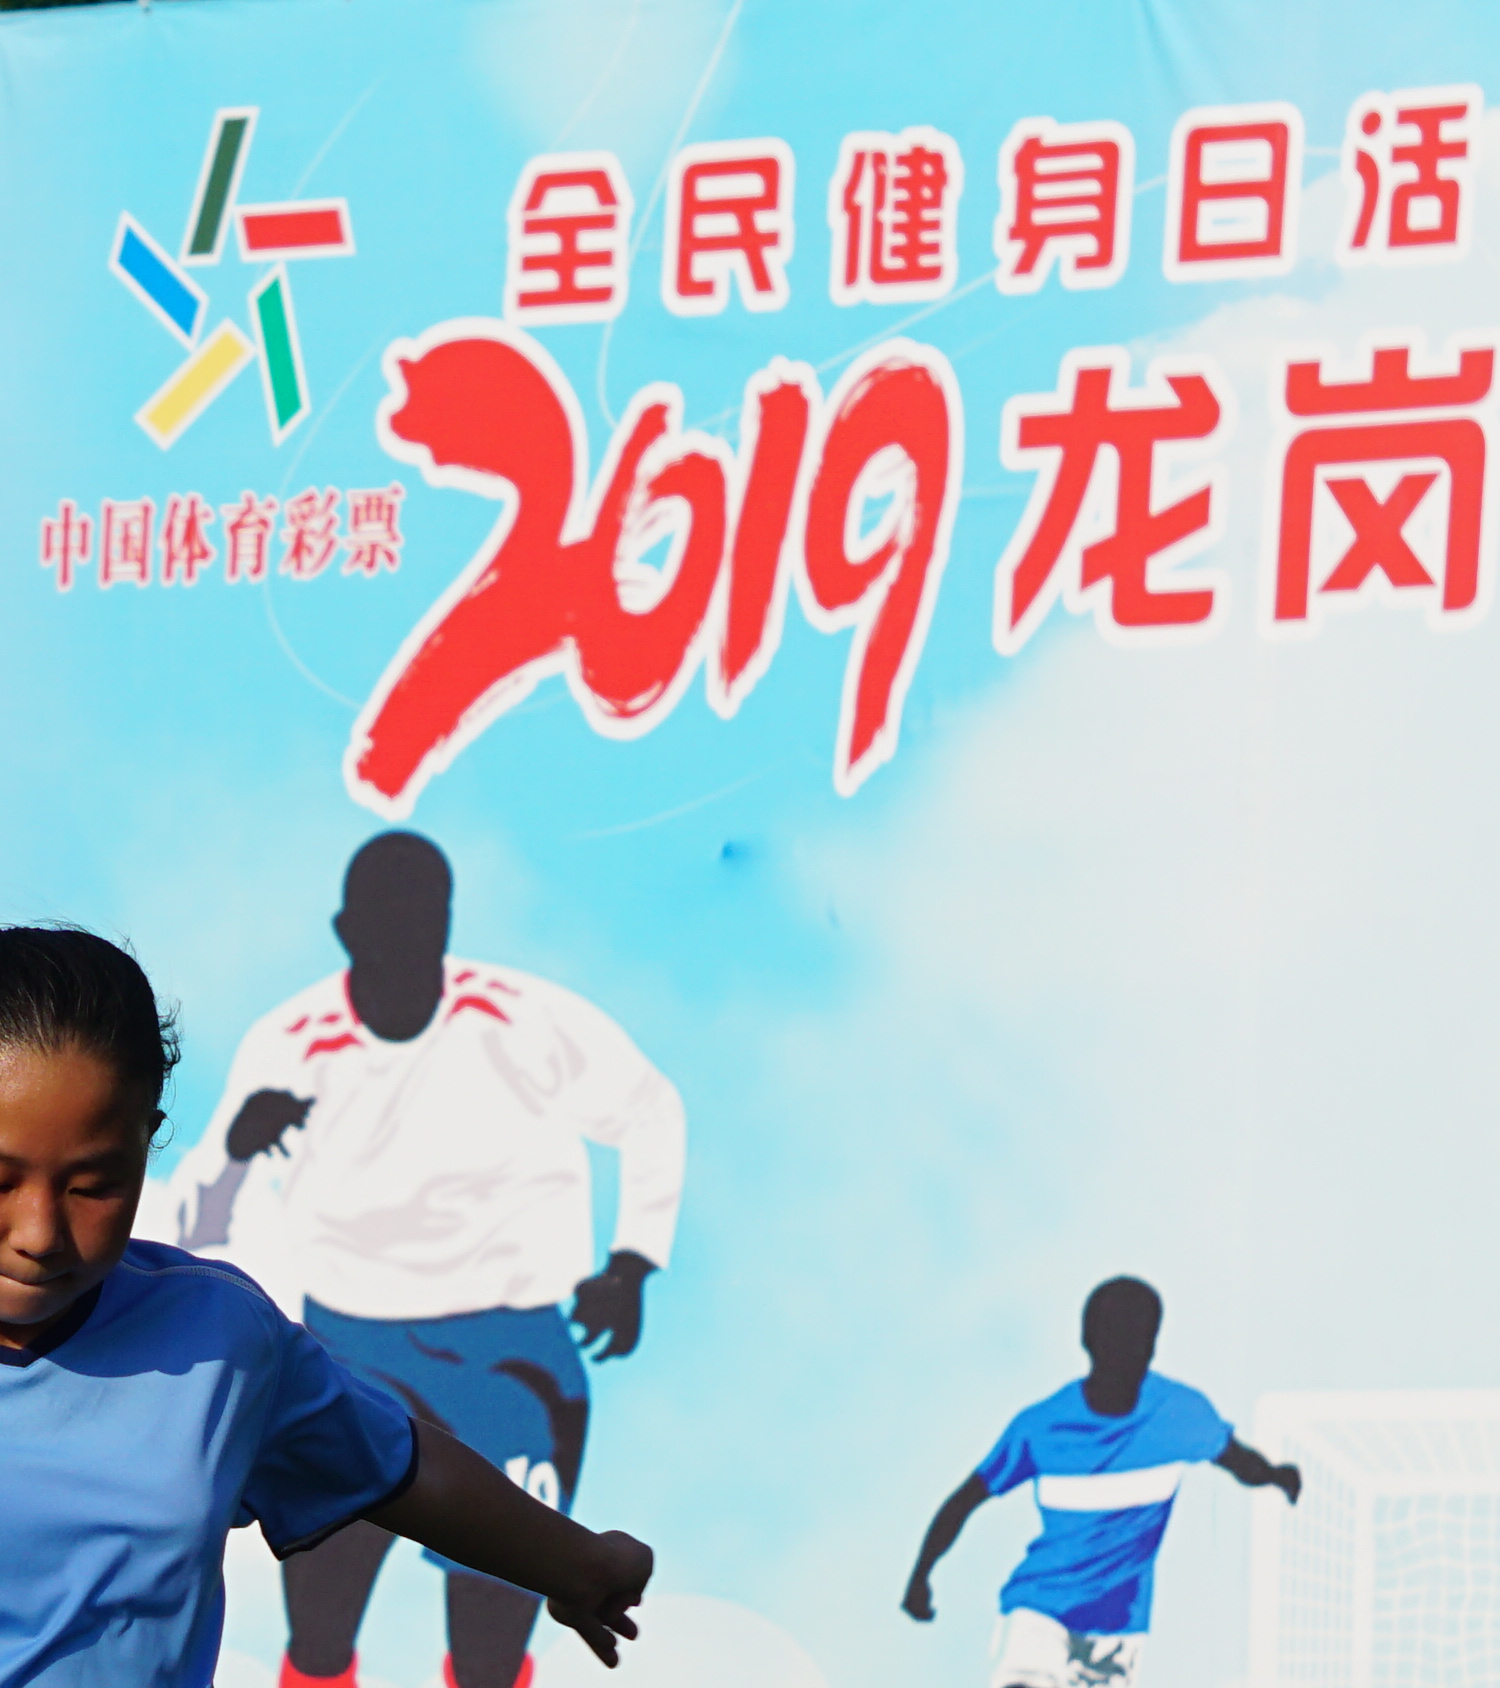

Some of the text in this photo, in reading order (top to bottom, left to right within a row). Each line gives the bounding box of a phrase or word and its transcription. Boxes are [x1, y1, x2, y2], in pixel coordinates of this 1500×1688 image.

[42, 488, 403, 586] 中国体育彩票
